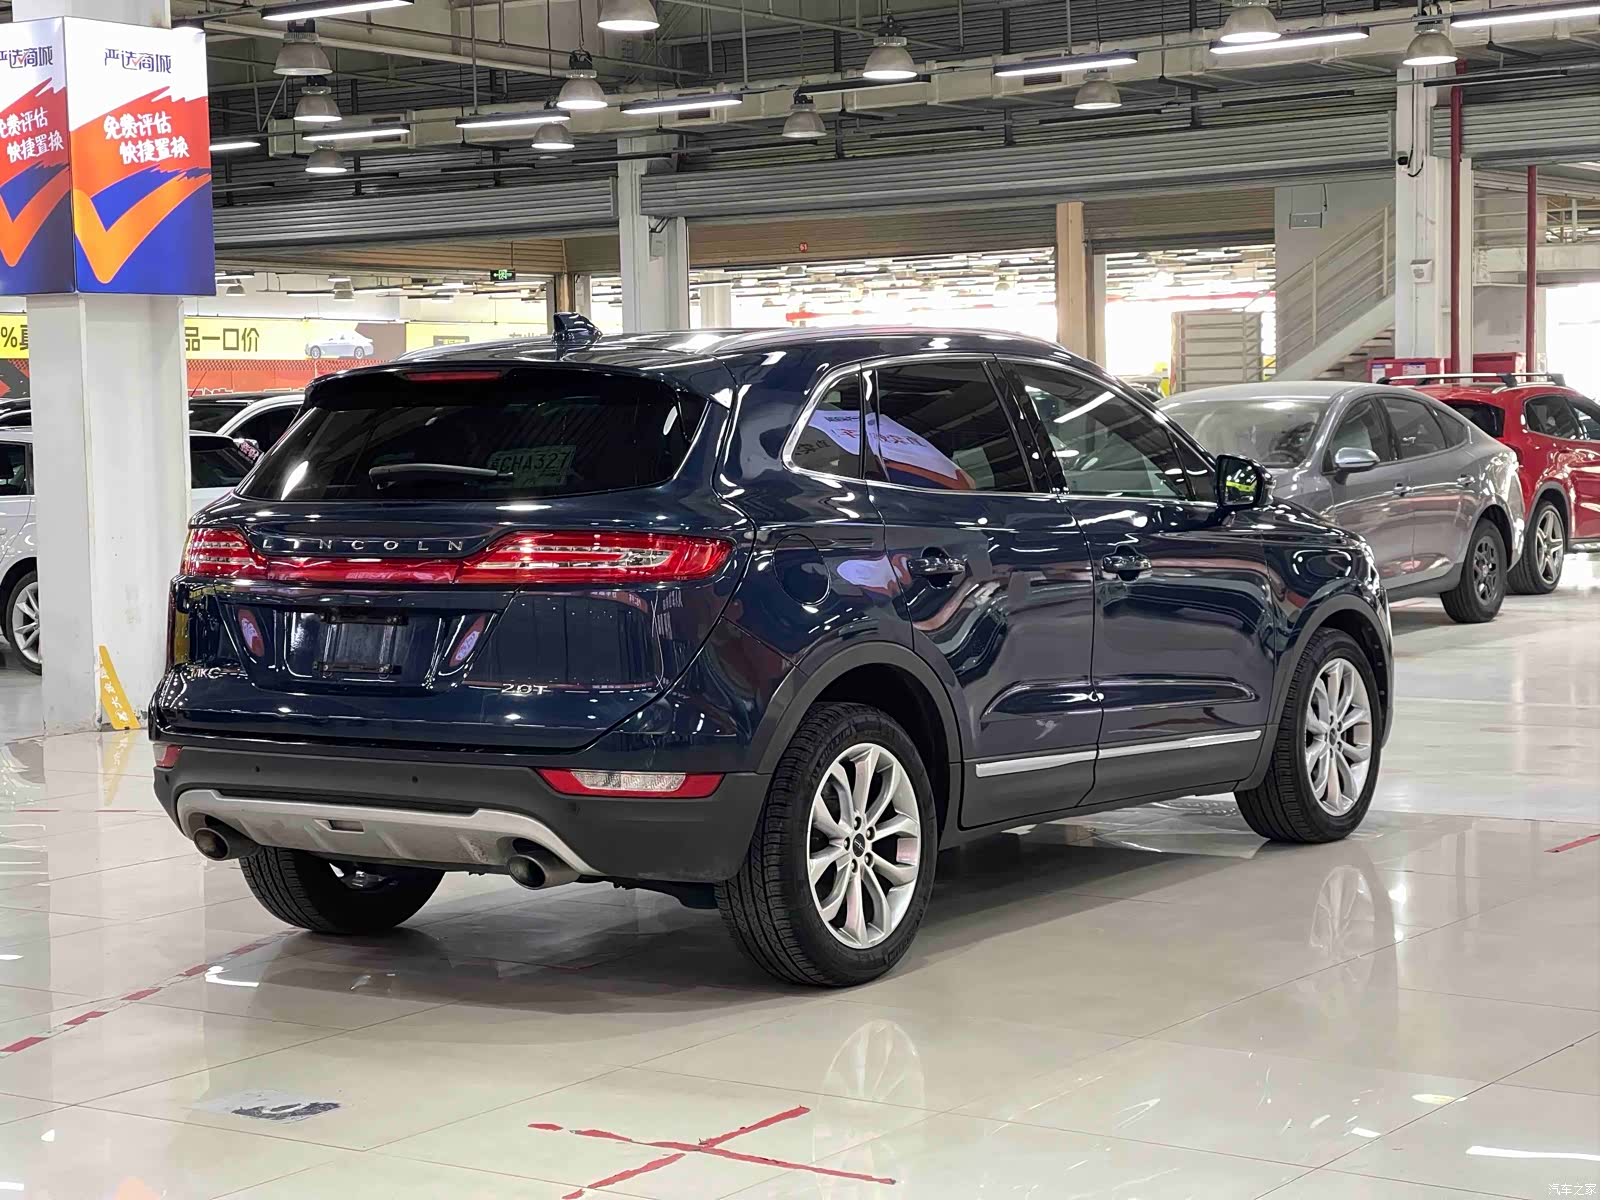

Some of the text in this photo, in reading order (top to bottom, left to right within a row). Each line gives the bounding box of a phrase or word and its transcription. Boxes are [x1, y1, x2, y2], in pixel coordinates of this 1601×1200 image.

[105, 48, 172, 73] 严选商城
[103, 111, 172, 140] 免费评估
[6, 130, 64, 163] 快捷置换
[119, 136, 190, 164] 快捷置换
[185, 327, 260, 352] 品一口价
